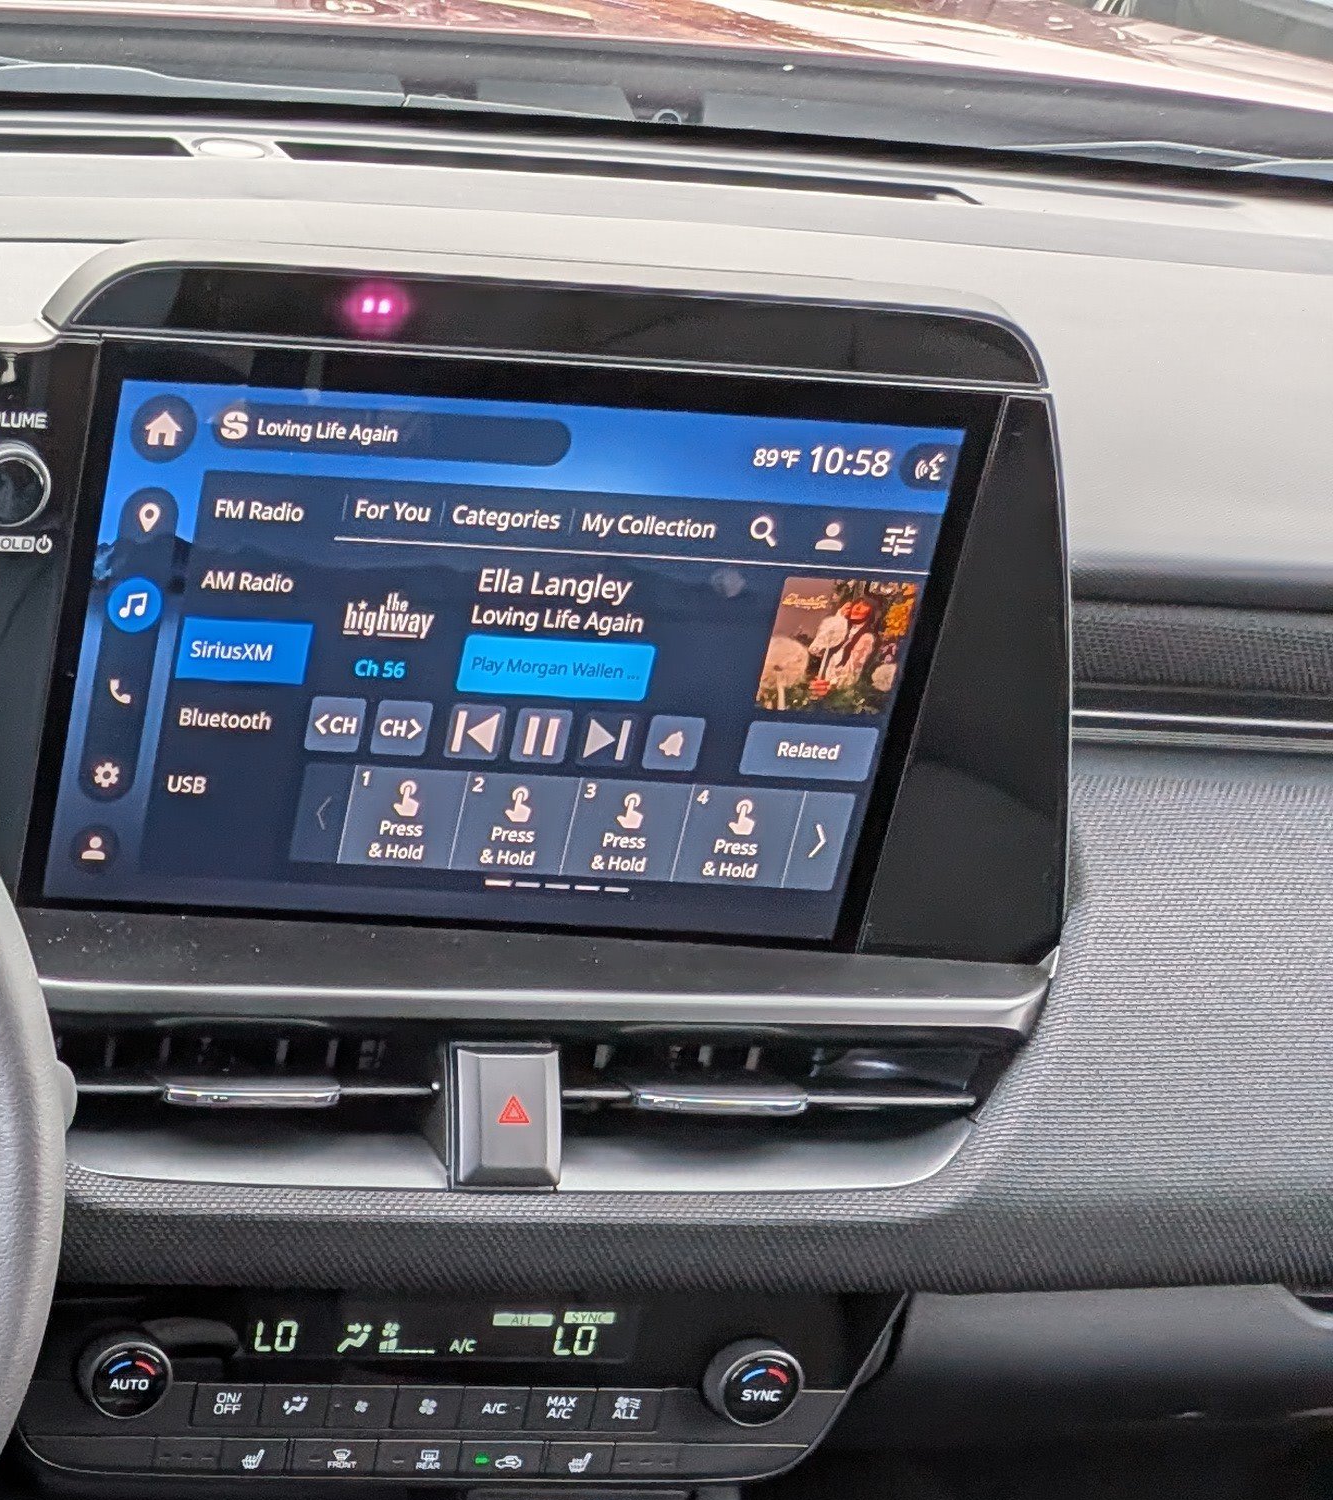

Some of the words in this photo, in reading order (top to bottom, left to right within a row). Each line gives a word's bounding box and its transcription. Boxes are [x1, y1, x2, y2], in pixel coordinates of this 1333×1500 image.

[257, 418, 312, 443] Loving
[316, 422, 347, 440] Life
[349, 424, 398, 445] Again
[810, 445, 891, 478] 10:58
[214, 499, 245, 520] FM
[249, 500, 304, 522] Radio
[355, 500, 388, 521] For
[392, 502, 431, 523] You
[453, 505, 561, 530] Categories
[582, 514, 615, 540] My
[617, 515, 716, 539] Collection
[201, 570, 234, 591] AM
[239, 572, 294, 593] Radio
[478, 568, 524, 594] Ella
[531, 571, 633, 606] Langley
[386, 592, 409, 612] the
[343, 600, 435, 639] highway
[471, 605, 539, 632] Loving
[543, 608, 581, 630] Life
[583, 611, 645, 636] Again
[190, 640, 273, 662] SiriusXM
[355, 659, 379, 677] Ch
[382, 661, 405, 679] 56
[471, 656, 504, 675] Play
[506, 658, 568, 678] Morgan
[573, 662, 624, 679] Wallen
[178, 706, 272, 731] Bluetooth
[777, 741, 840, 761] Related
[166, 775, 207, 795] USB
[361, 771, 370, 786] 1
[471, 777, 484, 793] 2
[584, 783, 596, 799] 3
[696, 789, 710, 805] 4
[380, 820, 423, 837] Press
[491, 826, 535, 844] Press
[602, 833, 646, 850] Press
[714, 839, 758, 856] Press
[368, 843, 382, 859] &
[384, 842, 424, 860] Hold
[480, 850, 494, 865] &
[496, 849, 535, 867] Hold
[591, 856, 605, 871] &
[607, 855, 646, 873] Hold
[702, 862, 716, 878] &
[718, 861, 758, 879] Hold
[571, 1312, 606, 1324] SYNC
[254, 1320, 299, 1352] LO
[553, 1326, 597, 1356] LO
[449, 1338, 477, 1354] A/C
[110, 1378, 149, 1391] AUTO
[216, 1392, 242, 1403] ON/
[546, 1396, 578, 1408] MAX
[741, 1389, 782, 1402] SYNC
[213, 1404, 241, 1415] OFF
[482, 1403, 507, 1415] A/C
[546, 1408, 572, 1419] A/C
[612, 1408, 639, 1420] ALL
[416, 1460, 440, 1470] REAR
